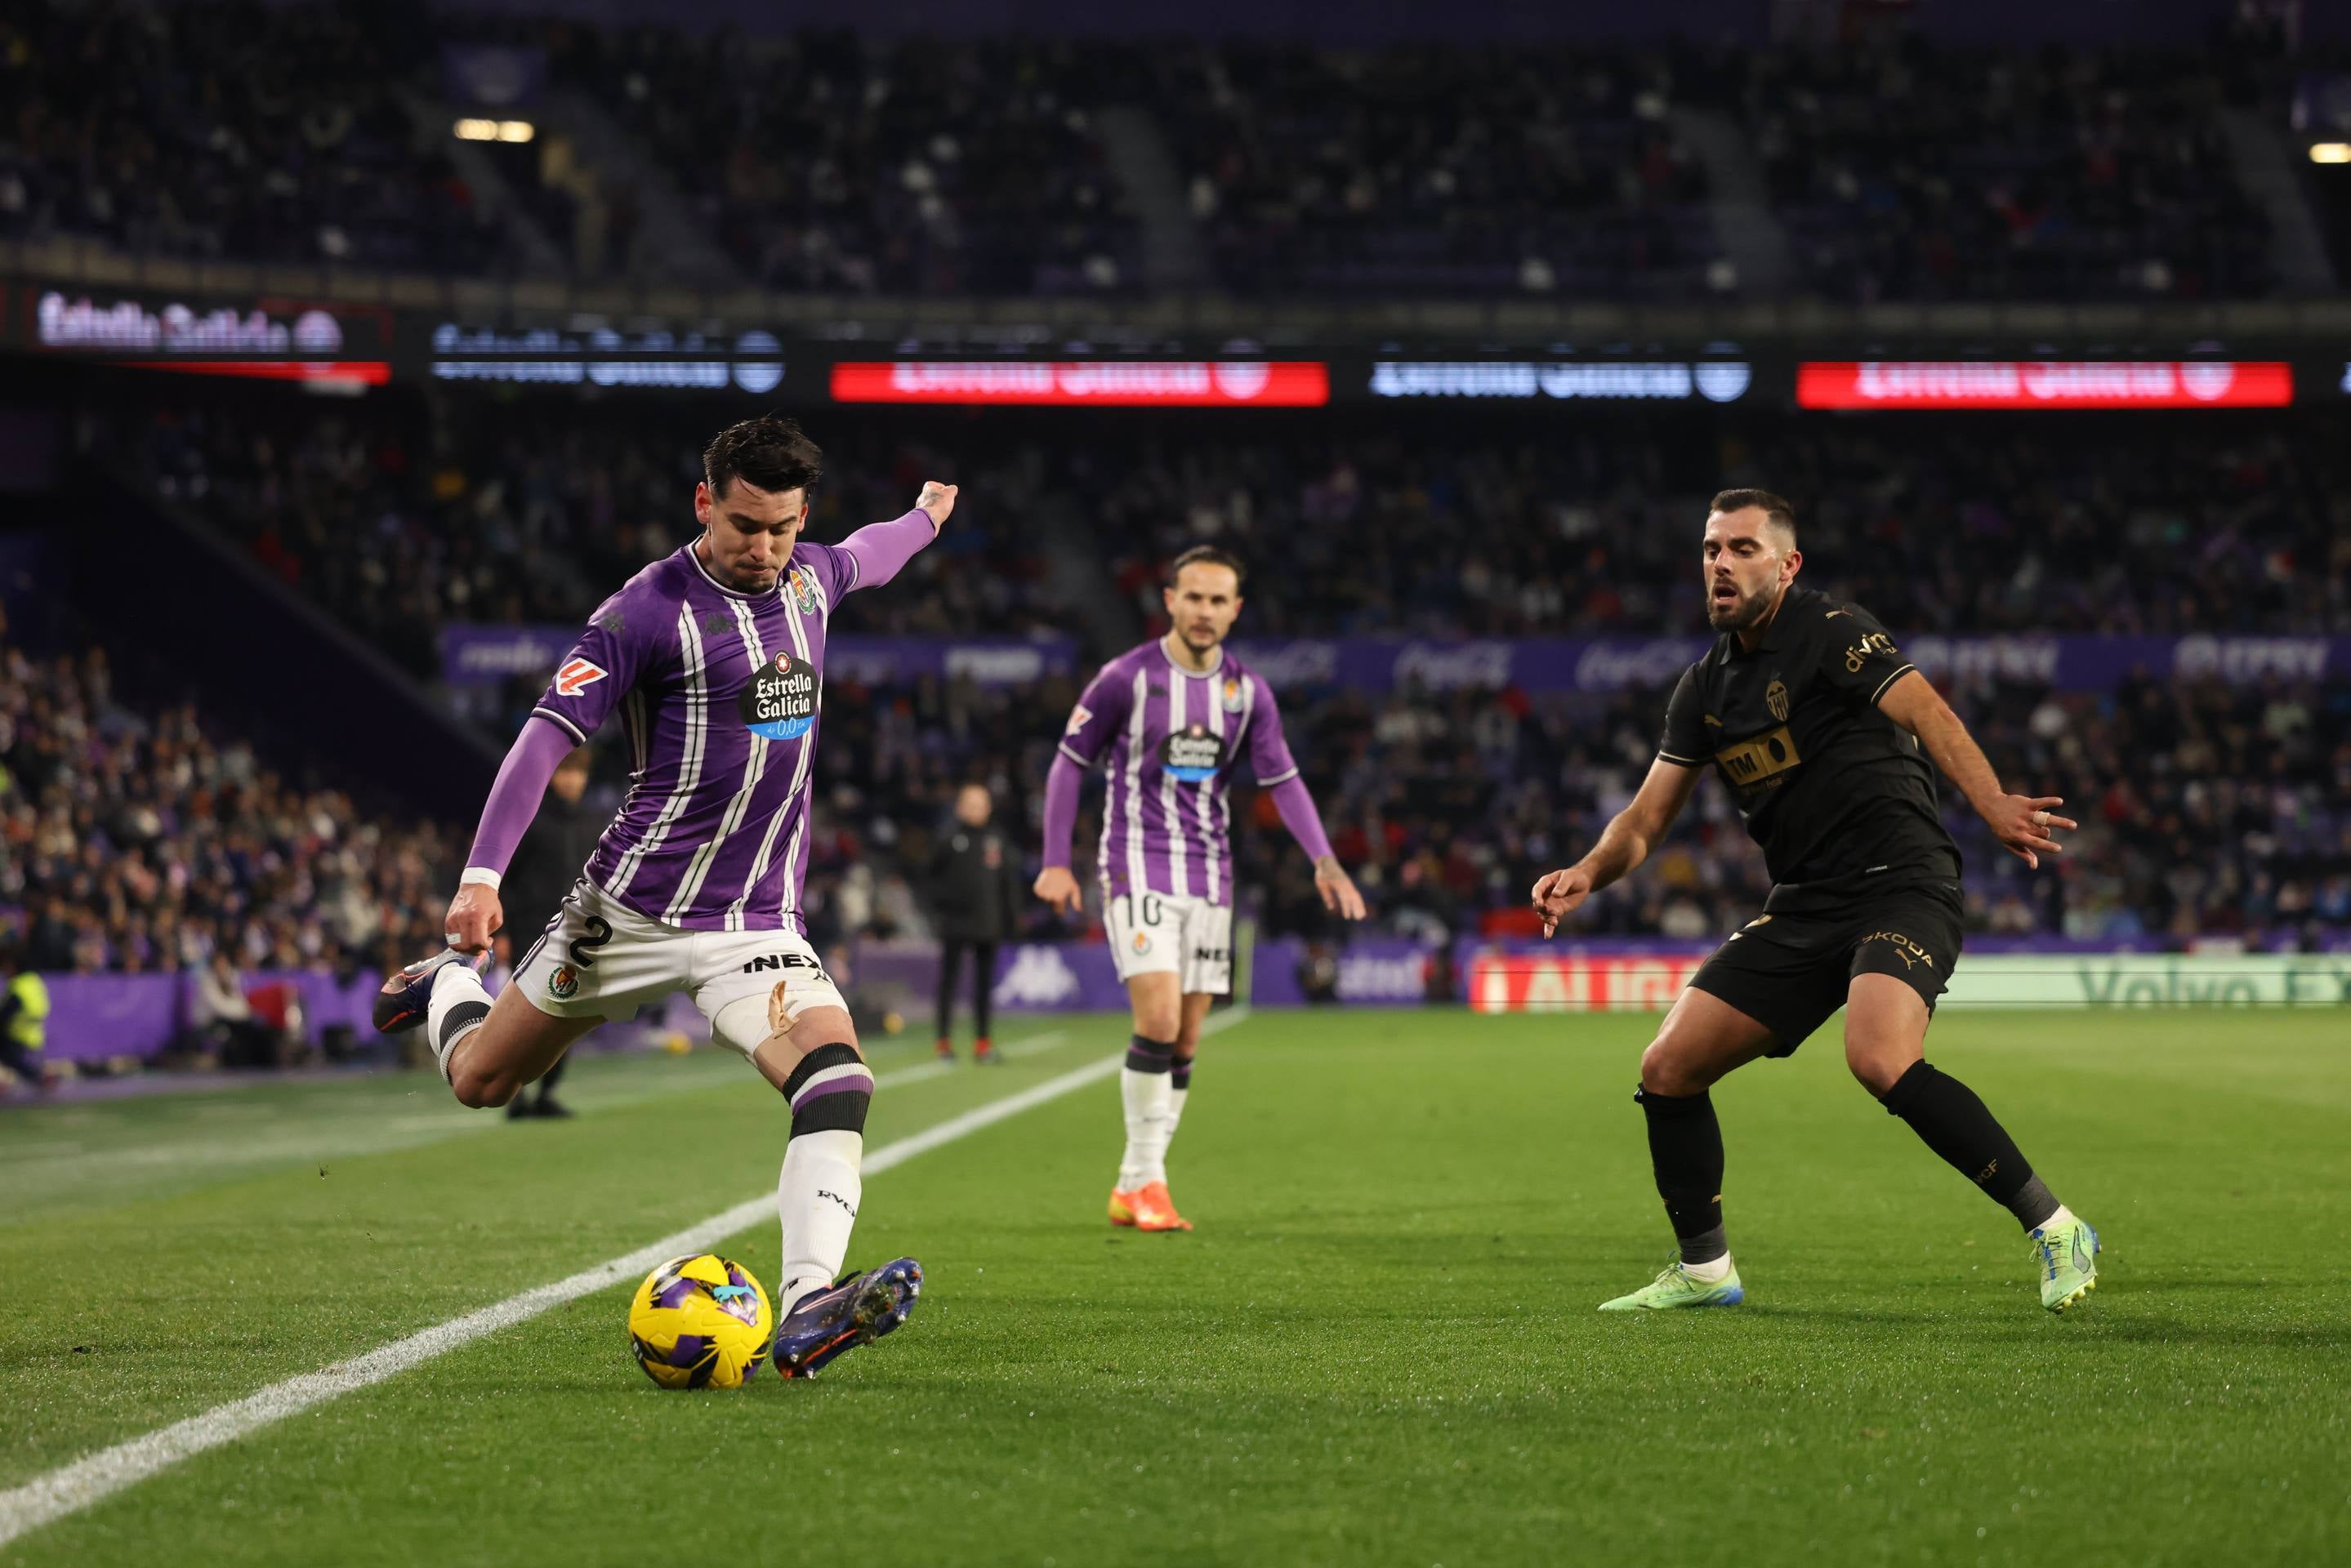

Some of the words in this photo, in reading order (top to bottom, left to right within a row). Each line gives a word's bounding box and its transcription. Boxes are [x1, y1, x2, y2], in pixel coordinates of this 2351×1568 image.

[756, 673, 812, 699] Estrella
[756, 694, 810, 719] Galicia
[1726, 751, 1757, 777] TM
[1126, 893, 1162, 927] 10
[569, 915, 613, 968] 2
[2076, 952, 2260, 1006] Volvo
[817, 1190, 855, 1218] RVC
